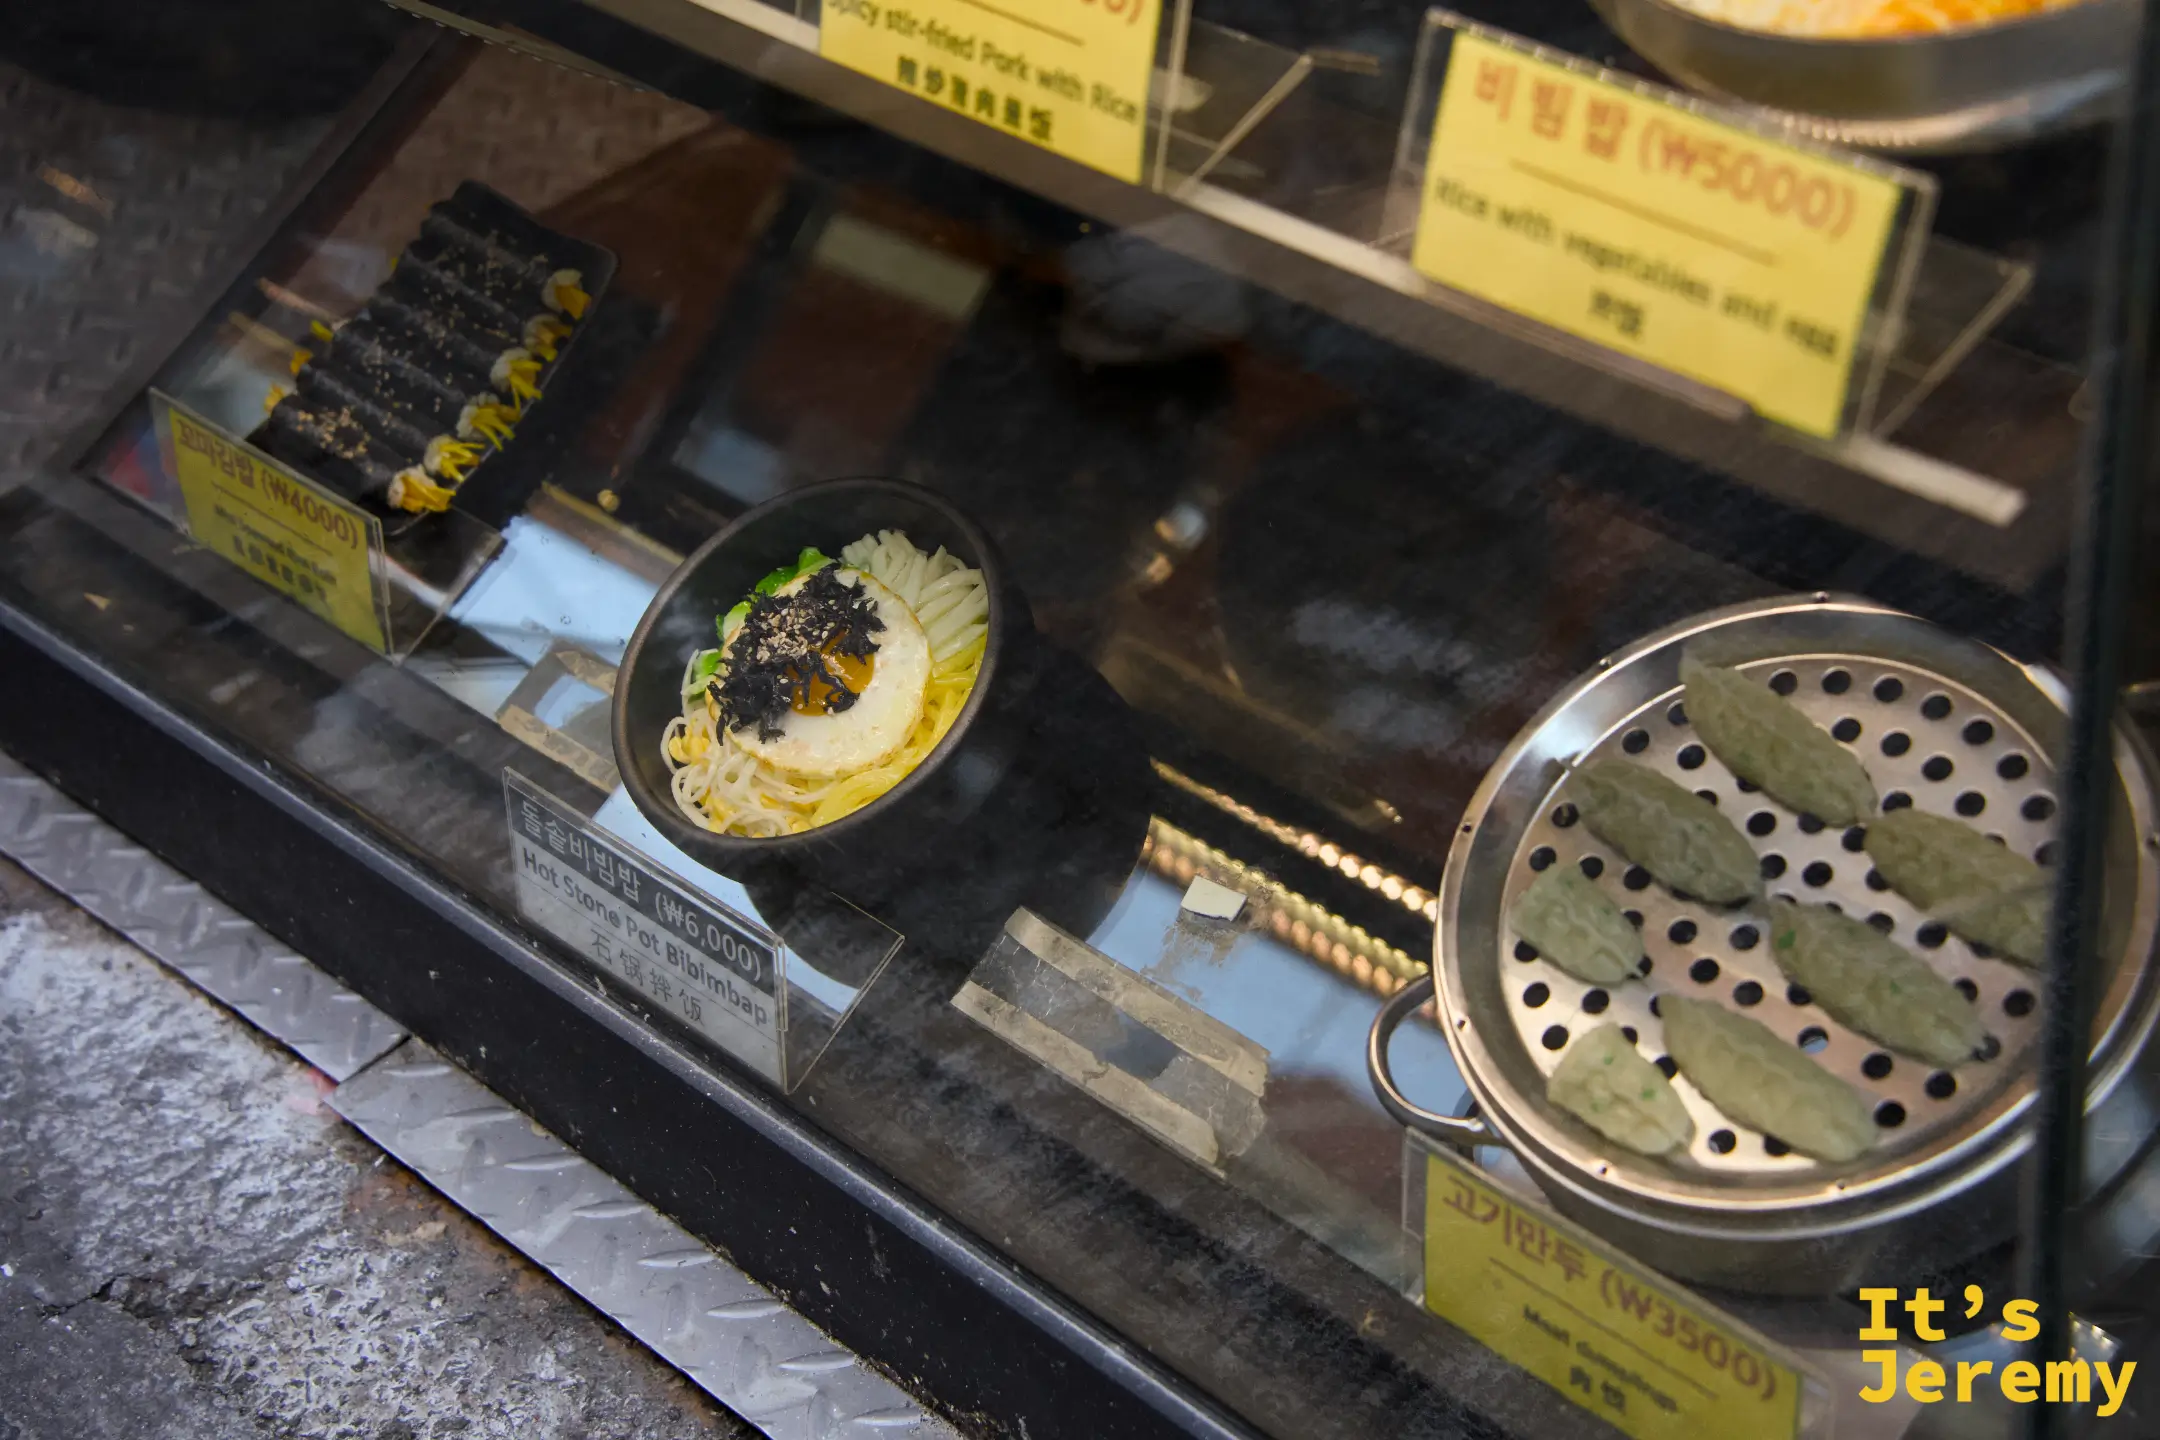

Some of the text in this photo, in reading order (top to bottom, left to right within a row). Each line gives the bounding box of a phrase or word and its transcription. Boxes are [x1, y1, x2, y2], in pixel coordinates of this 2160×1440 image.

[885, 7, 975, 62] stir-fried
[980, 40, 1030, 83] Pork
[1035, 65, 1083, 98] with
[1090, 82, 1139, 125] Rice
[1435, 176, 1490, 222] Rice
[1496, 202, 1555, 247] with
[1719, 290, 1780, 332] and
[521, 799, 641, 904] 돌솥비빔밥
[523, 847, 768, 1026] Hot Stone Pot Bibimbap
[590, 928, 705, 1027] 石锅拌饭
[1443, 1174, 1589, 1282] 고기만두
